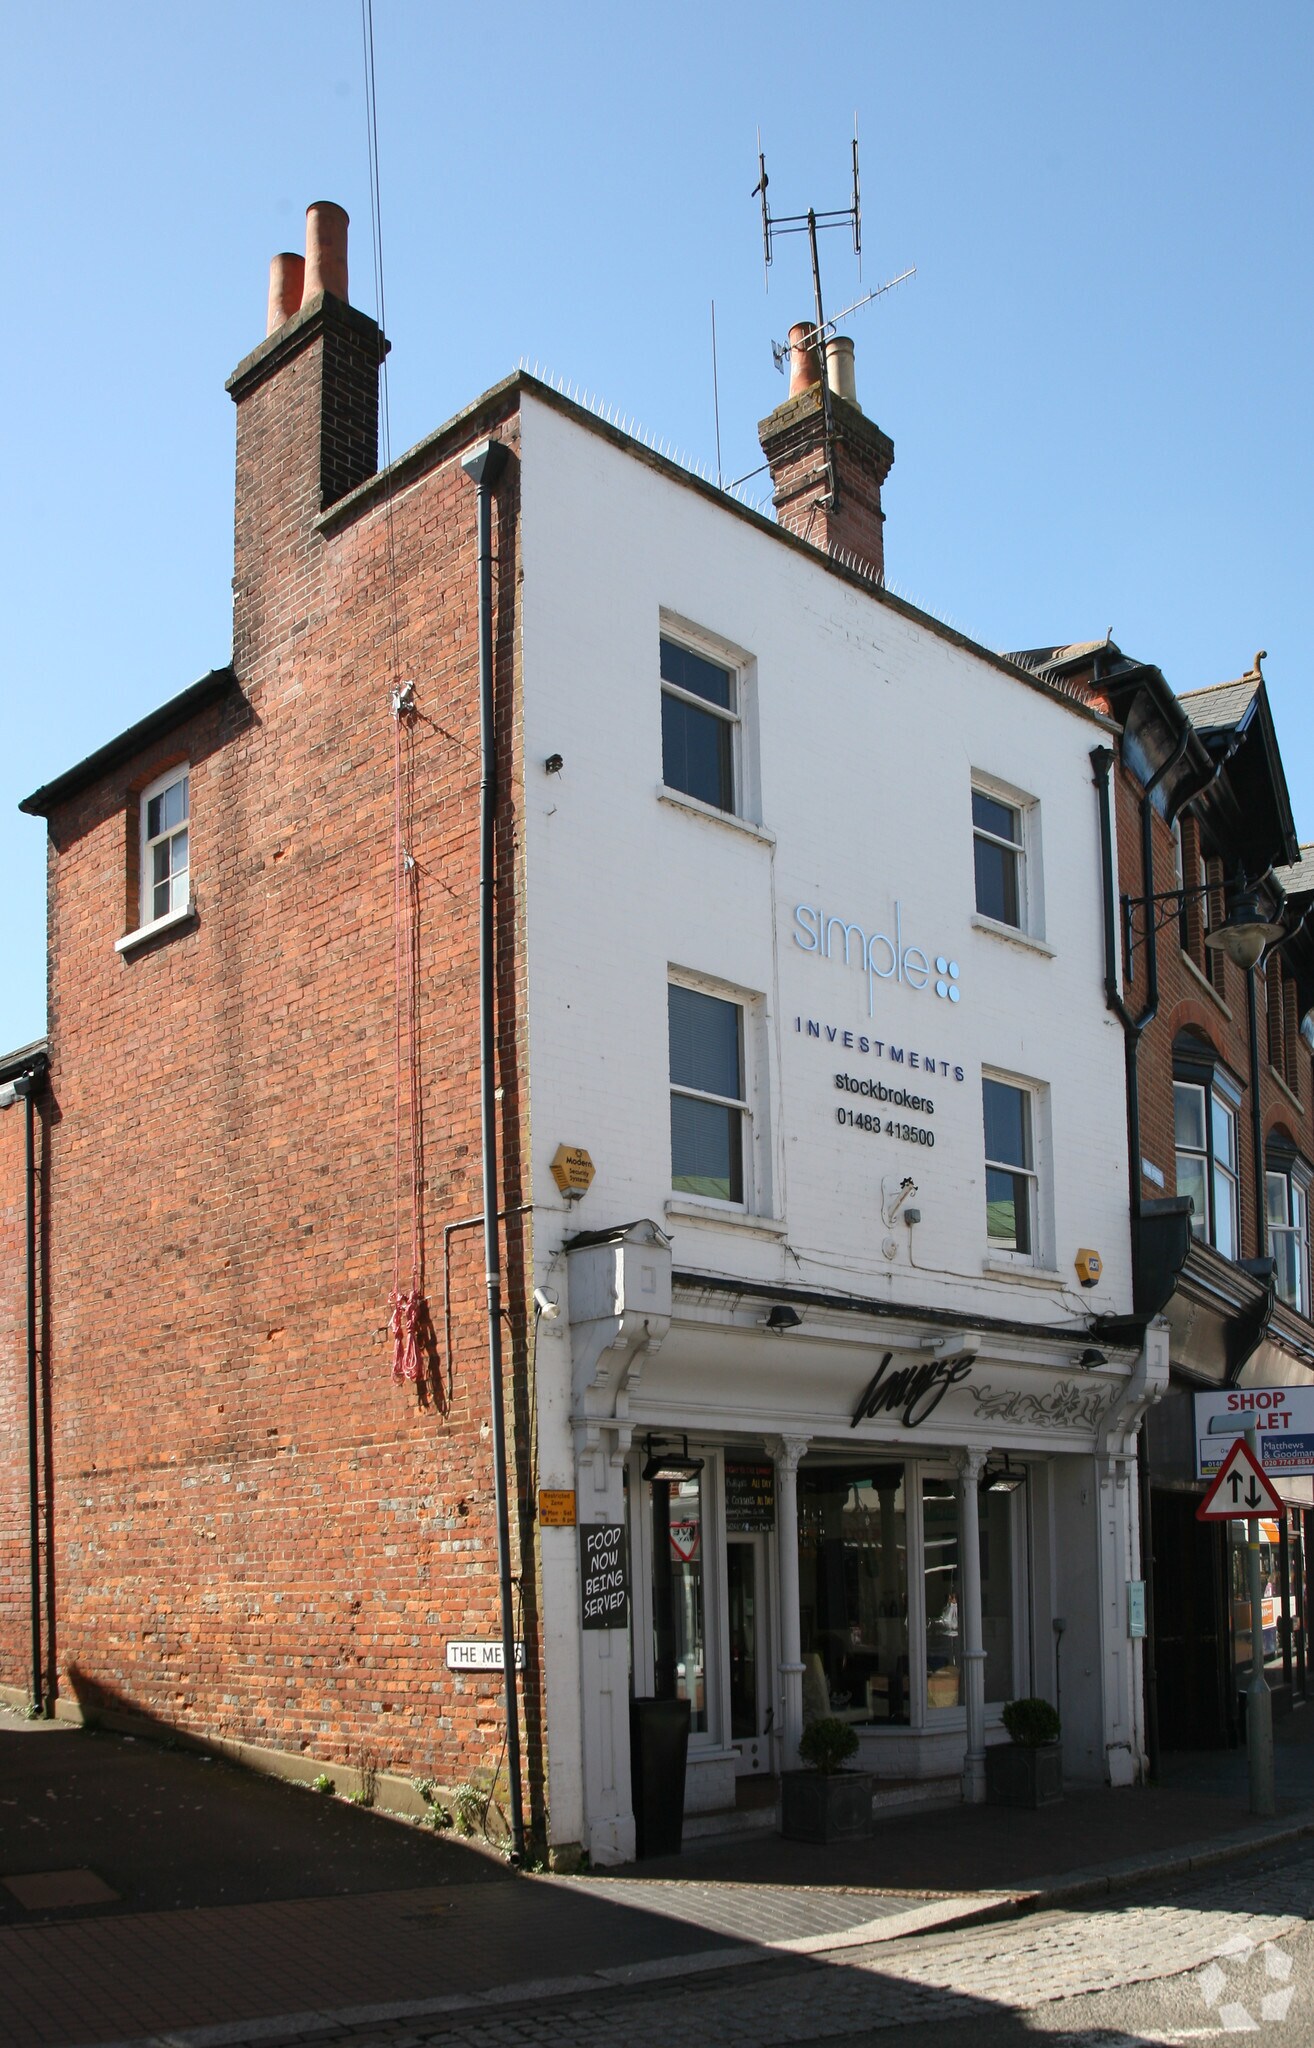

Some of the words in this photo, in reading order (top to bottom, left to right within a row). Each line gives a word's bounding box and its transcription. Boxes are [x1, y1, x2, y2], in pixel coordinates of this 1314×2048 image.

[794, 900, 930, 1017] simple
[796, 1016, 965, 1082] INVESTMENTS
[835, 1073, 935, 1114] stockbrokers
[837, 1107, 881, 1134] 01483
[886, 1121, 935, 1147] 413500
[566, 1156, 593, 1167] Modern
[1227, 1391, 1286, 1411] SHOP
[1256, 1411, 1293, 1430] LET
[1263, 1441, 1304, 1450] Matthews
[1263, 1451, 1271, 1459] &
[587, 1528, 621, 1552] FOOD
[591, 1549, 618, 1573] NOW
[586, 1569, 623, 1596] BEING
[584, 1590, 625, 1619] SERVED
[451, 1647, 477, 1662] THE
[482, 1647, 522, 1663] MES
